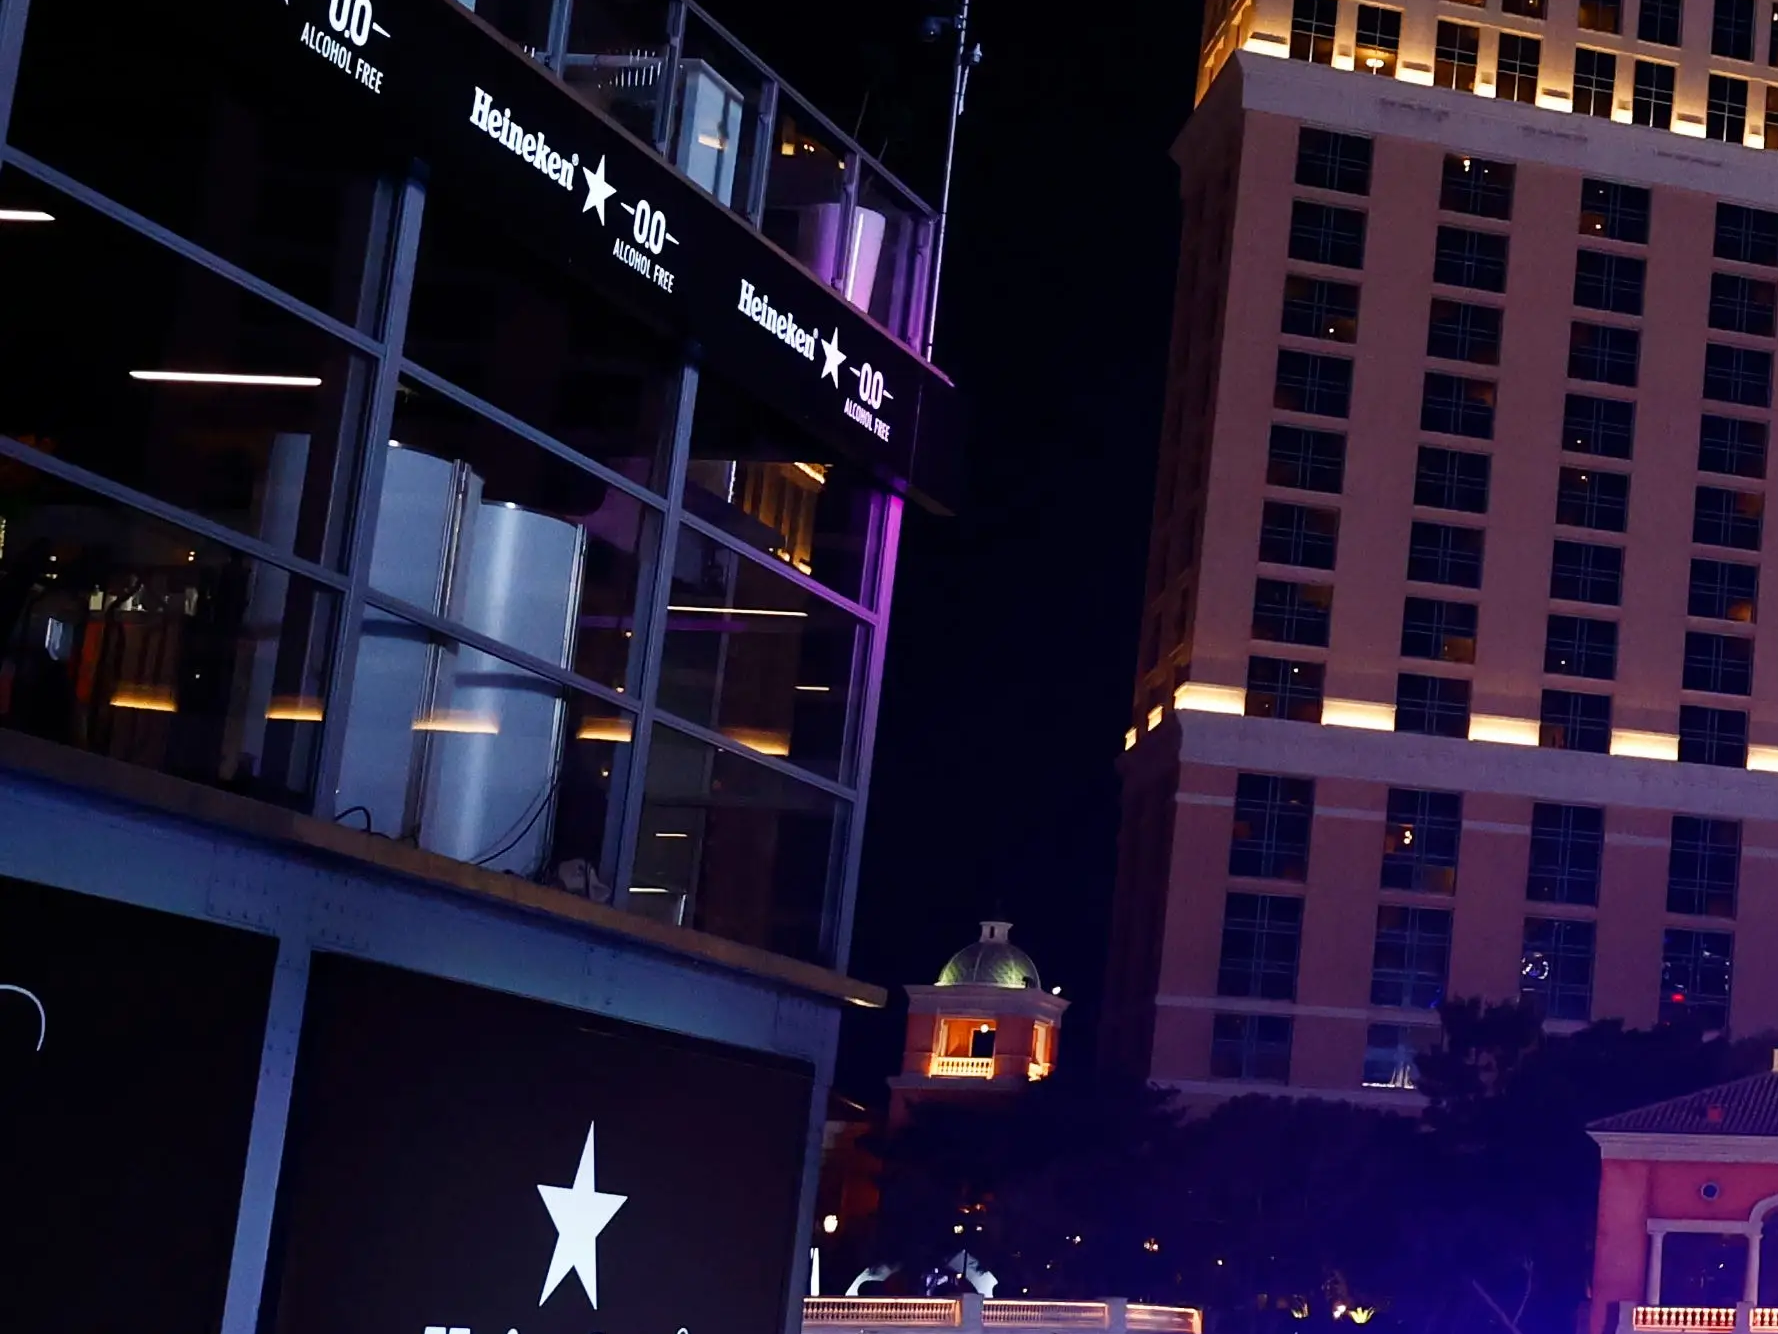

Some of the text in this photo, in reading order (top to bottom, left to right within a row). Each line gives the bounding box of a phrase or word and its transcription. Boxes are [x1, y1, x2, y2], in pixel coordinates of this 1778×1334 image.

[300, 22, 384, 95] ALCOHOL FREE
[613, 237, 675, 294] ALCOHOL FREE
[843, 397, 891, 443] ALCOHOL FREE
